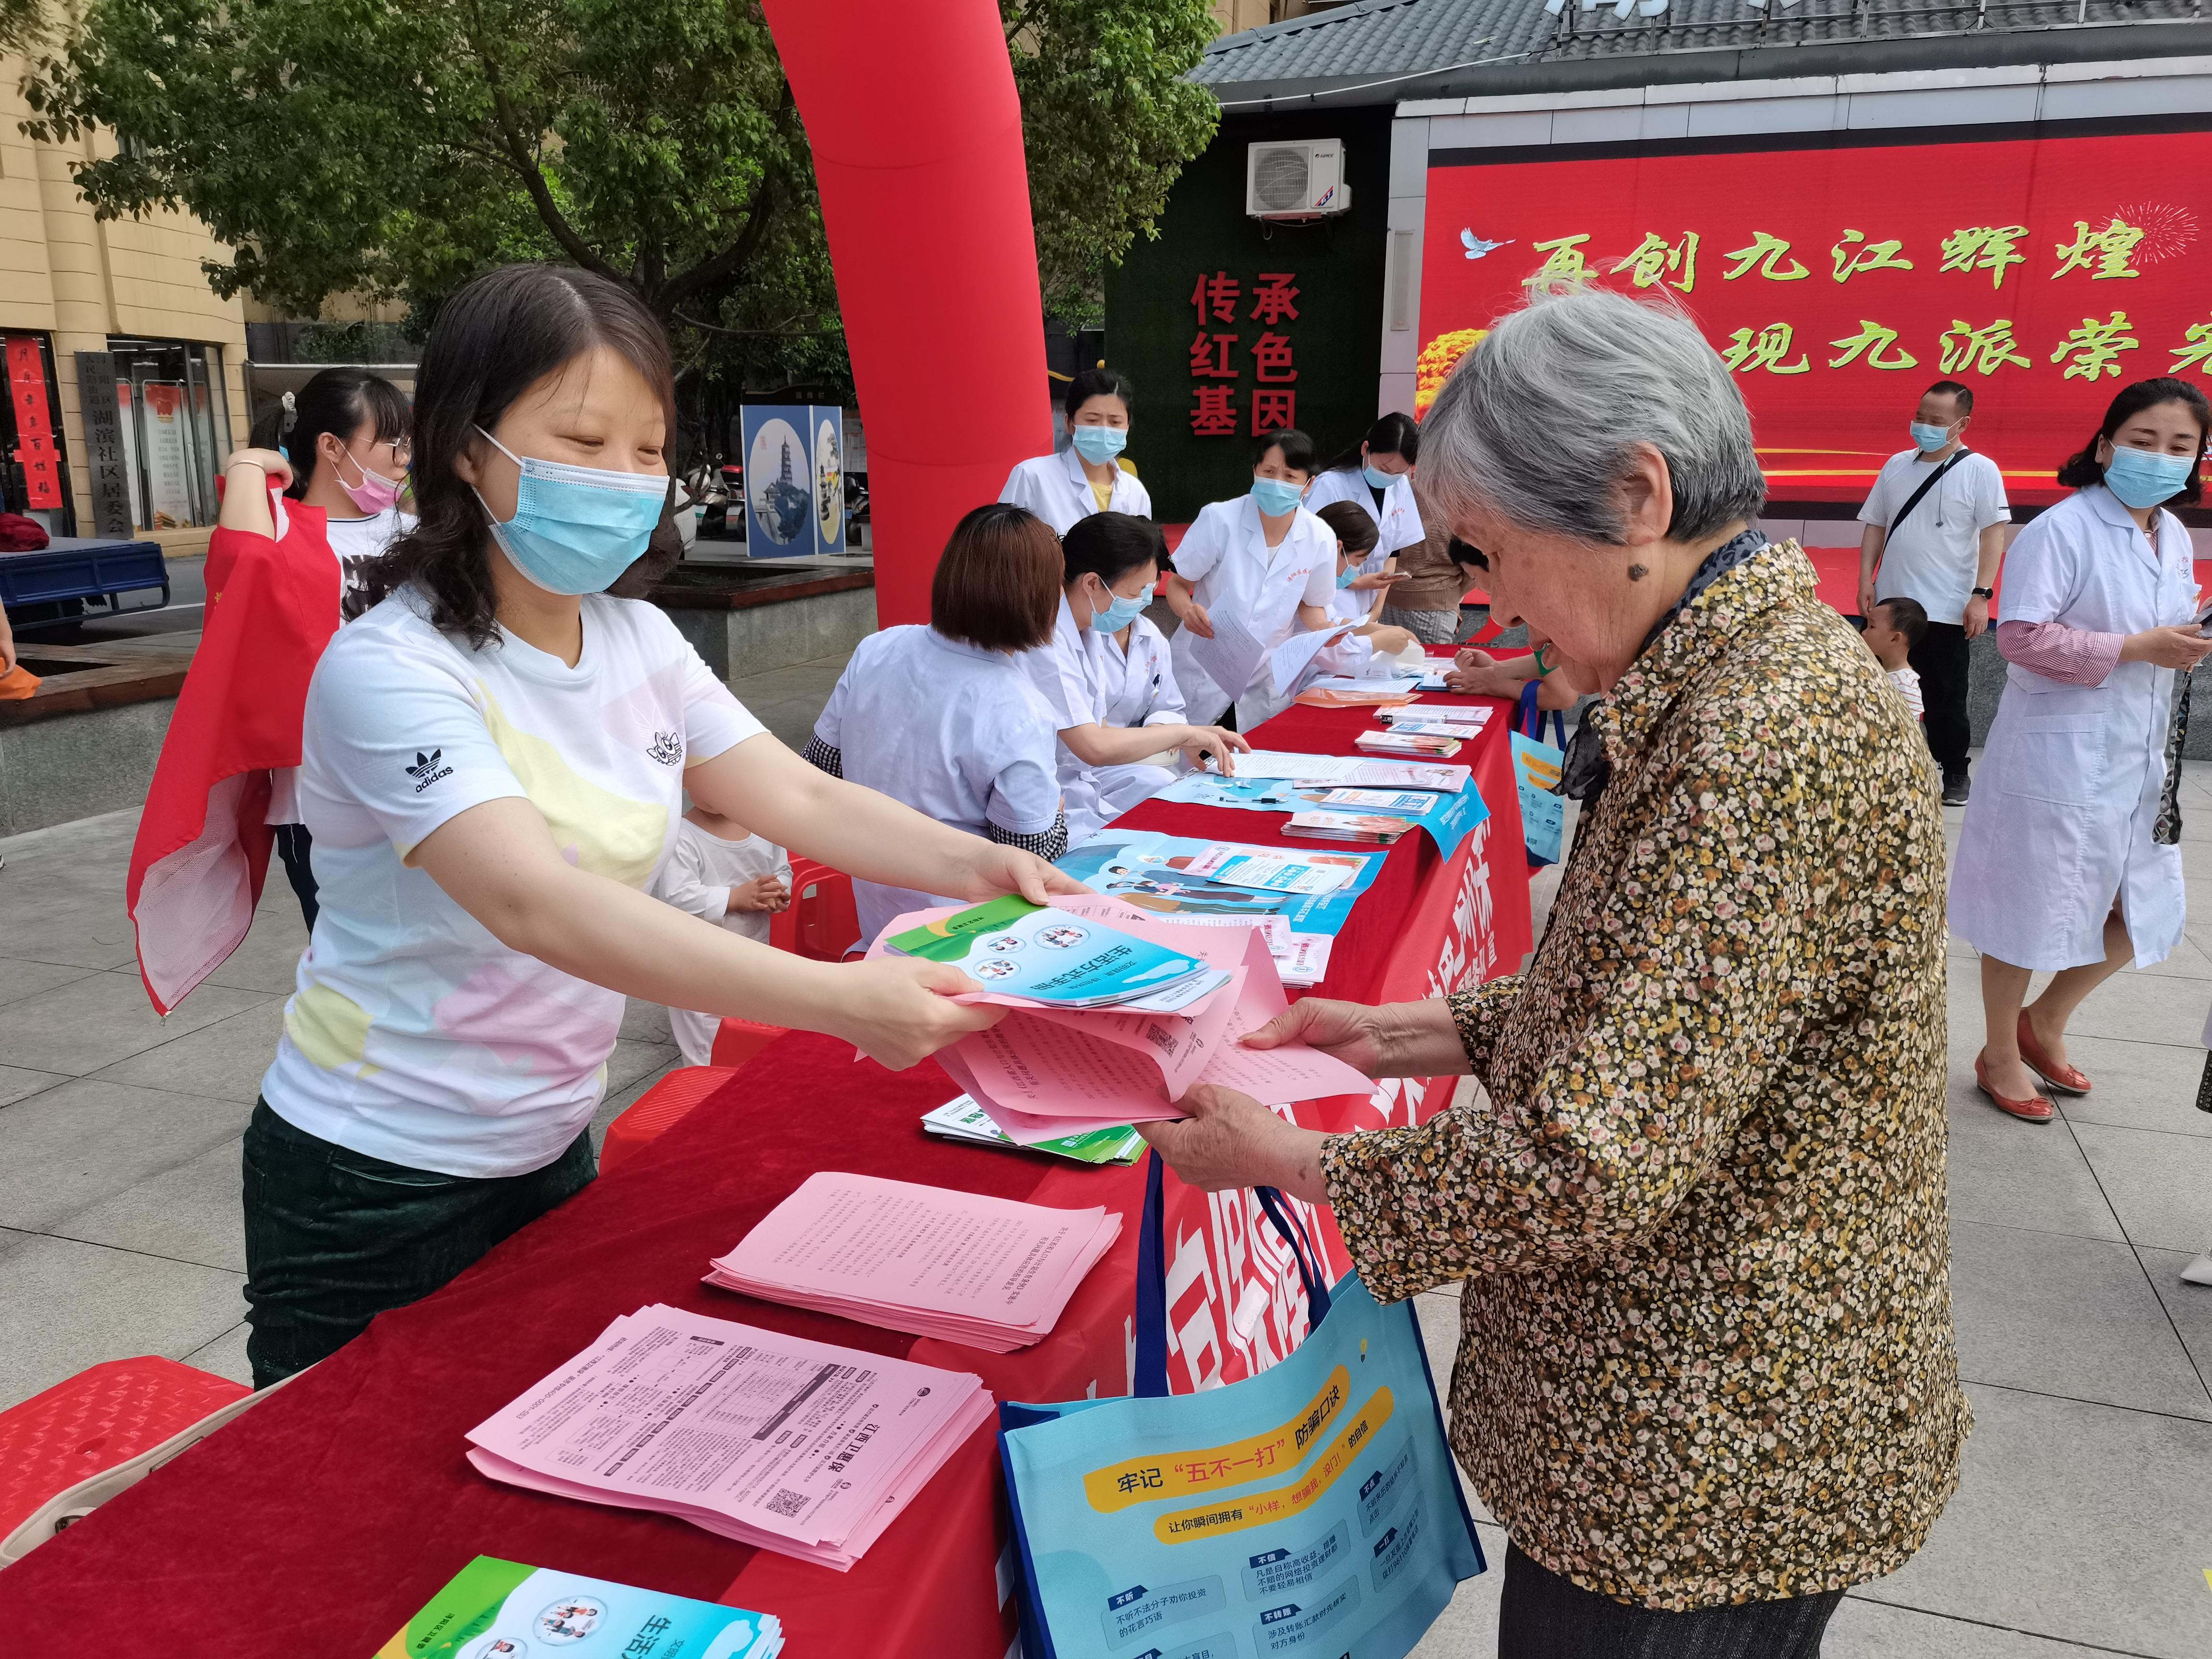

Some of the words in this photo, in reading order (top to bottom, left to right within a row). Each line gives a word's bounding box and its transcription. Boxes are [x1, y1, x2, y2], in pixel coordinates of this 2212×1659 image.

[1521, 219, 2144, 294] 再创九江辉煌
[1190, 271, 1300, 325] 传承
[1190, 331, 1298, 382] 红色
[1190, 385, 1296, 437] 基因
[93, 409, 124, 534] 湖滨社区居委会
[416, 764, 454, 793] adidas
[1029, 945, 1132, 990] 生活方式手册
[826, 1423, 882, 1473] 江西卫惠保
[1117, 1467, 1164, 1494] 牢记
[1174, 1438, 1286, 1483] “五不一打”
[1295, 1384, 1341, 1450] 防骗口诀
[1168, 1508, 1243, 1534] 让你瞬间拥有
[1347, 1419, 1370, 1449] 的自信
[1363, 1478, 1376, 1494] 不点
[1369, 1511, 1380, 1526] 点击
[1257, 1553, 1277, 1564] 不信
[1378, 1537, 1390, 1550] 一打
[1257, 1544, 1339, 1586] 不赔的网络投资理财都
[1115, 1591, 1135, 1606] 不听
[1259, 1573, 1313, 1596] 不要轻易相信
[1115, 1587, 1208, 1625] 不听不法分子劝你投资
[1118, 1611, 1164, 1639] 的花言巧语
[1264, 1607, 1292, 1622] 不转账
[1270, 1632, 1306, 1651] 对方身份
